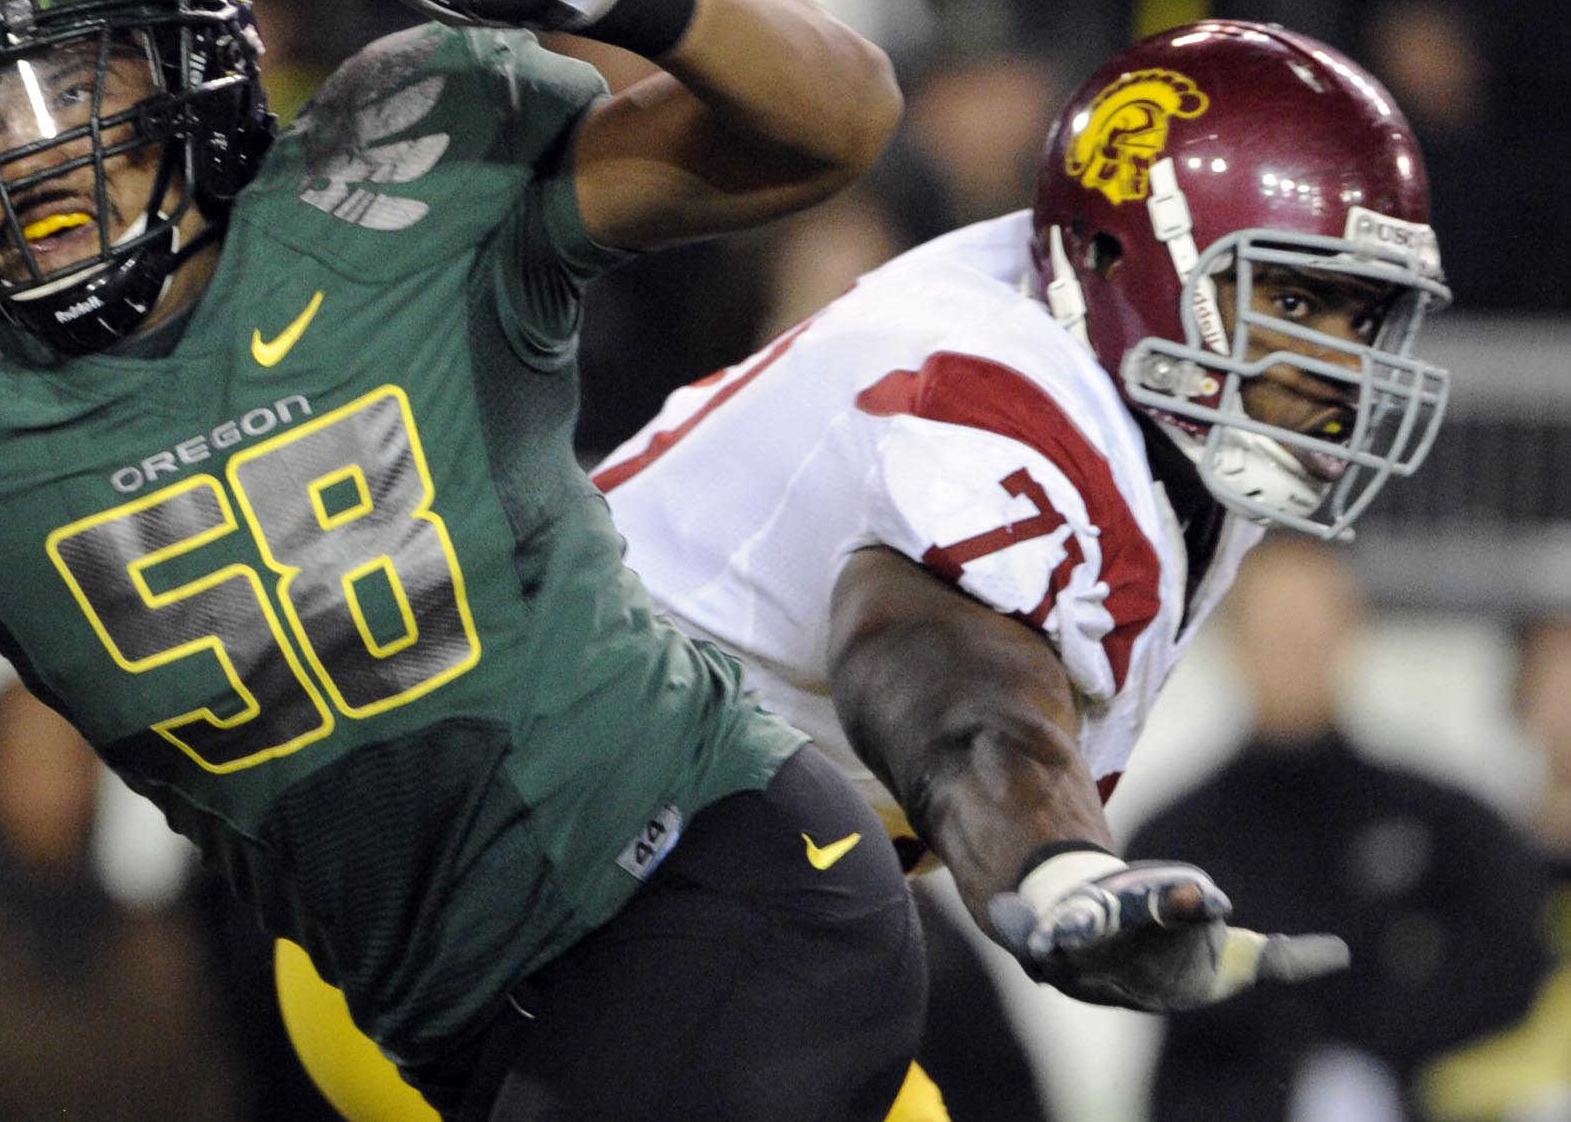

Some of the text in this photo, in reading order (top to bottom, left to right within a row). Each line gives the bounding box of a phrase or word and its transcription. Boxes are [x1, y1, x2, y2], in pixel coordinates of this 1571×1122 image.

[109, 394, 313, 494] OREGON
[45, 383, 481, 774] 58
[635, 819, 666, 865] 44
